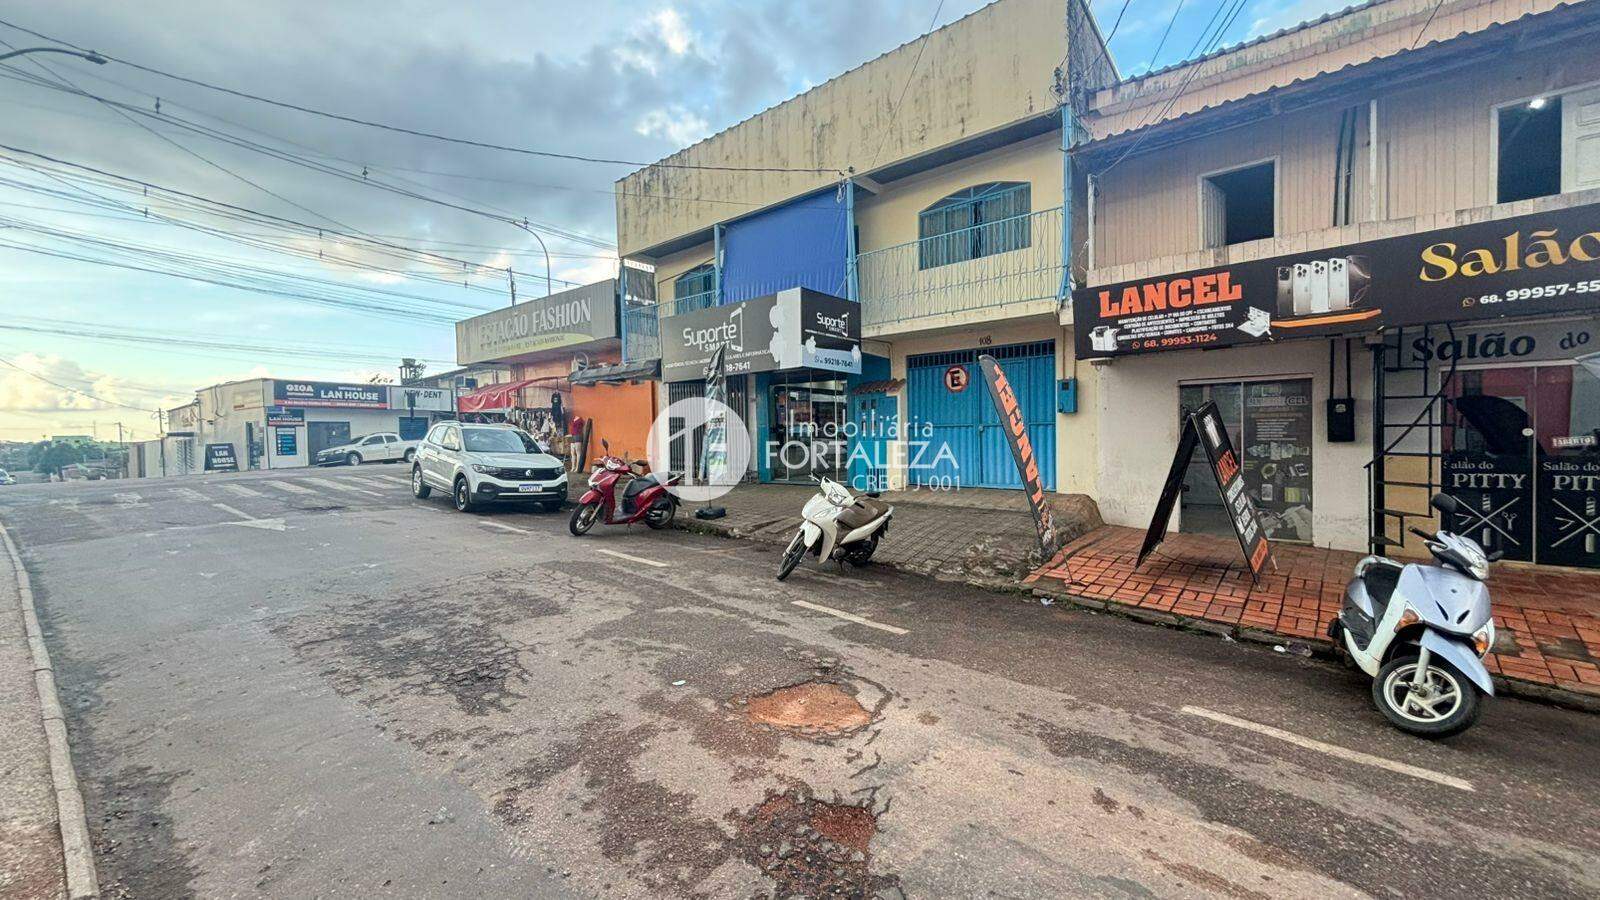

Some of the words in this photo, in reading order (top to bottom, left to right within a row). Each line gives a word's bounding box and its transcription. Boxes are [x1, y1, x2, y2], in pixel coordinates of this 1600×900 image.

[1420, 229, 1600, 282] Salão
[1099, 272, 1242, 318] LANCEL
[1480, 294, 1503, 305] 68.
[532, 297, 591, 333] FASHION
[816, 312, 845, 329] Suporte
[683, 321, 737, 350] Suporte
[1161, 333, 1217, 347] 99953-1124
[1412, 331, 1536, 361] Salão
[1559, 332, 1590, 350] do
[949, 369, 962, 388] E
[286, 383, 314, 393] GIGA
[320, 390, 344, 399] LAN
[345, 391, 379, 401] HOUSE
[211, 457, 236, 465] HOUSE
[1478, 460, 1494, 470] do
[1543, 461, 1580, 471] Salão
[1583, 462, 1600, 472] do
[1452, 473, 1526, 489] PITTY
[1552, 475, 1600, 491] PIT
